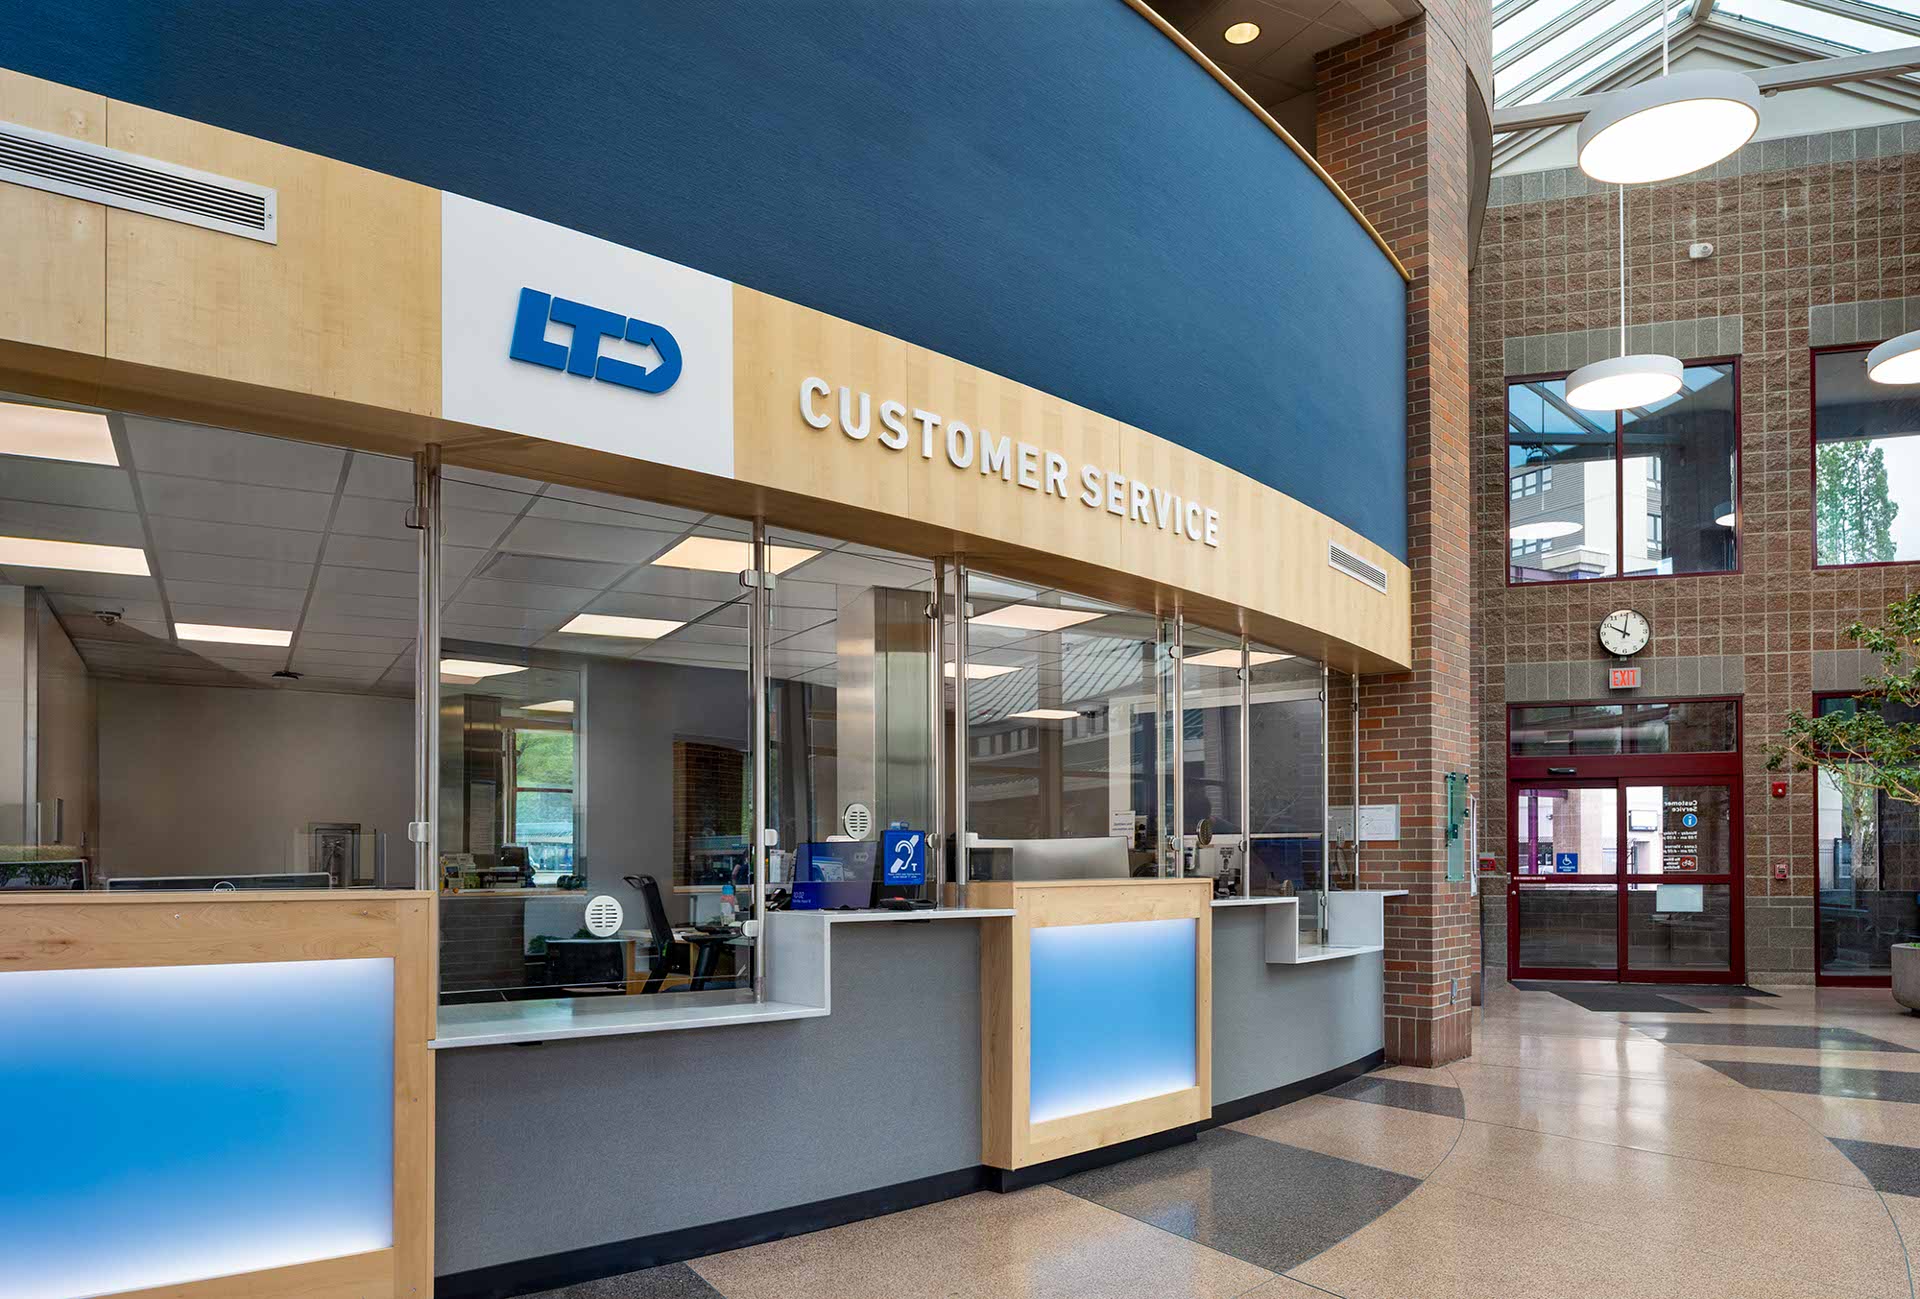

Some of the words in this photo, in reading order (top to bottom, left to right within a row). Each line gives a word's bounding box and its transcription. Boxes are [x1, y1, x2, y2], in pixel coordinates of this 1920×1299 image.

[510, 286, 683, 394] LTD
[800, 376, 1069, 499] CUSTOMER
[1080, 464, 1219, 547] SERVICE
[1612, 669, 1638, 687] EXIT
[911, 862, 918, 872] T
